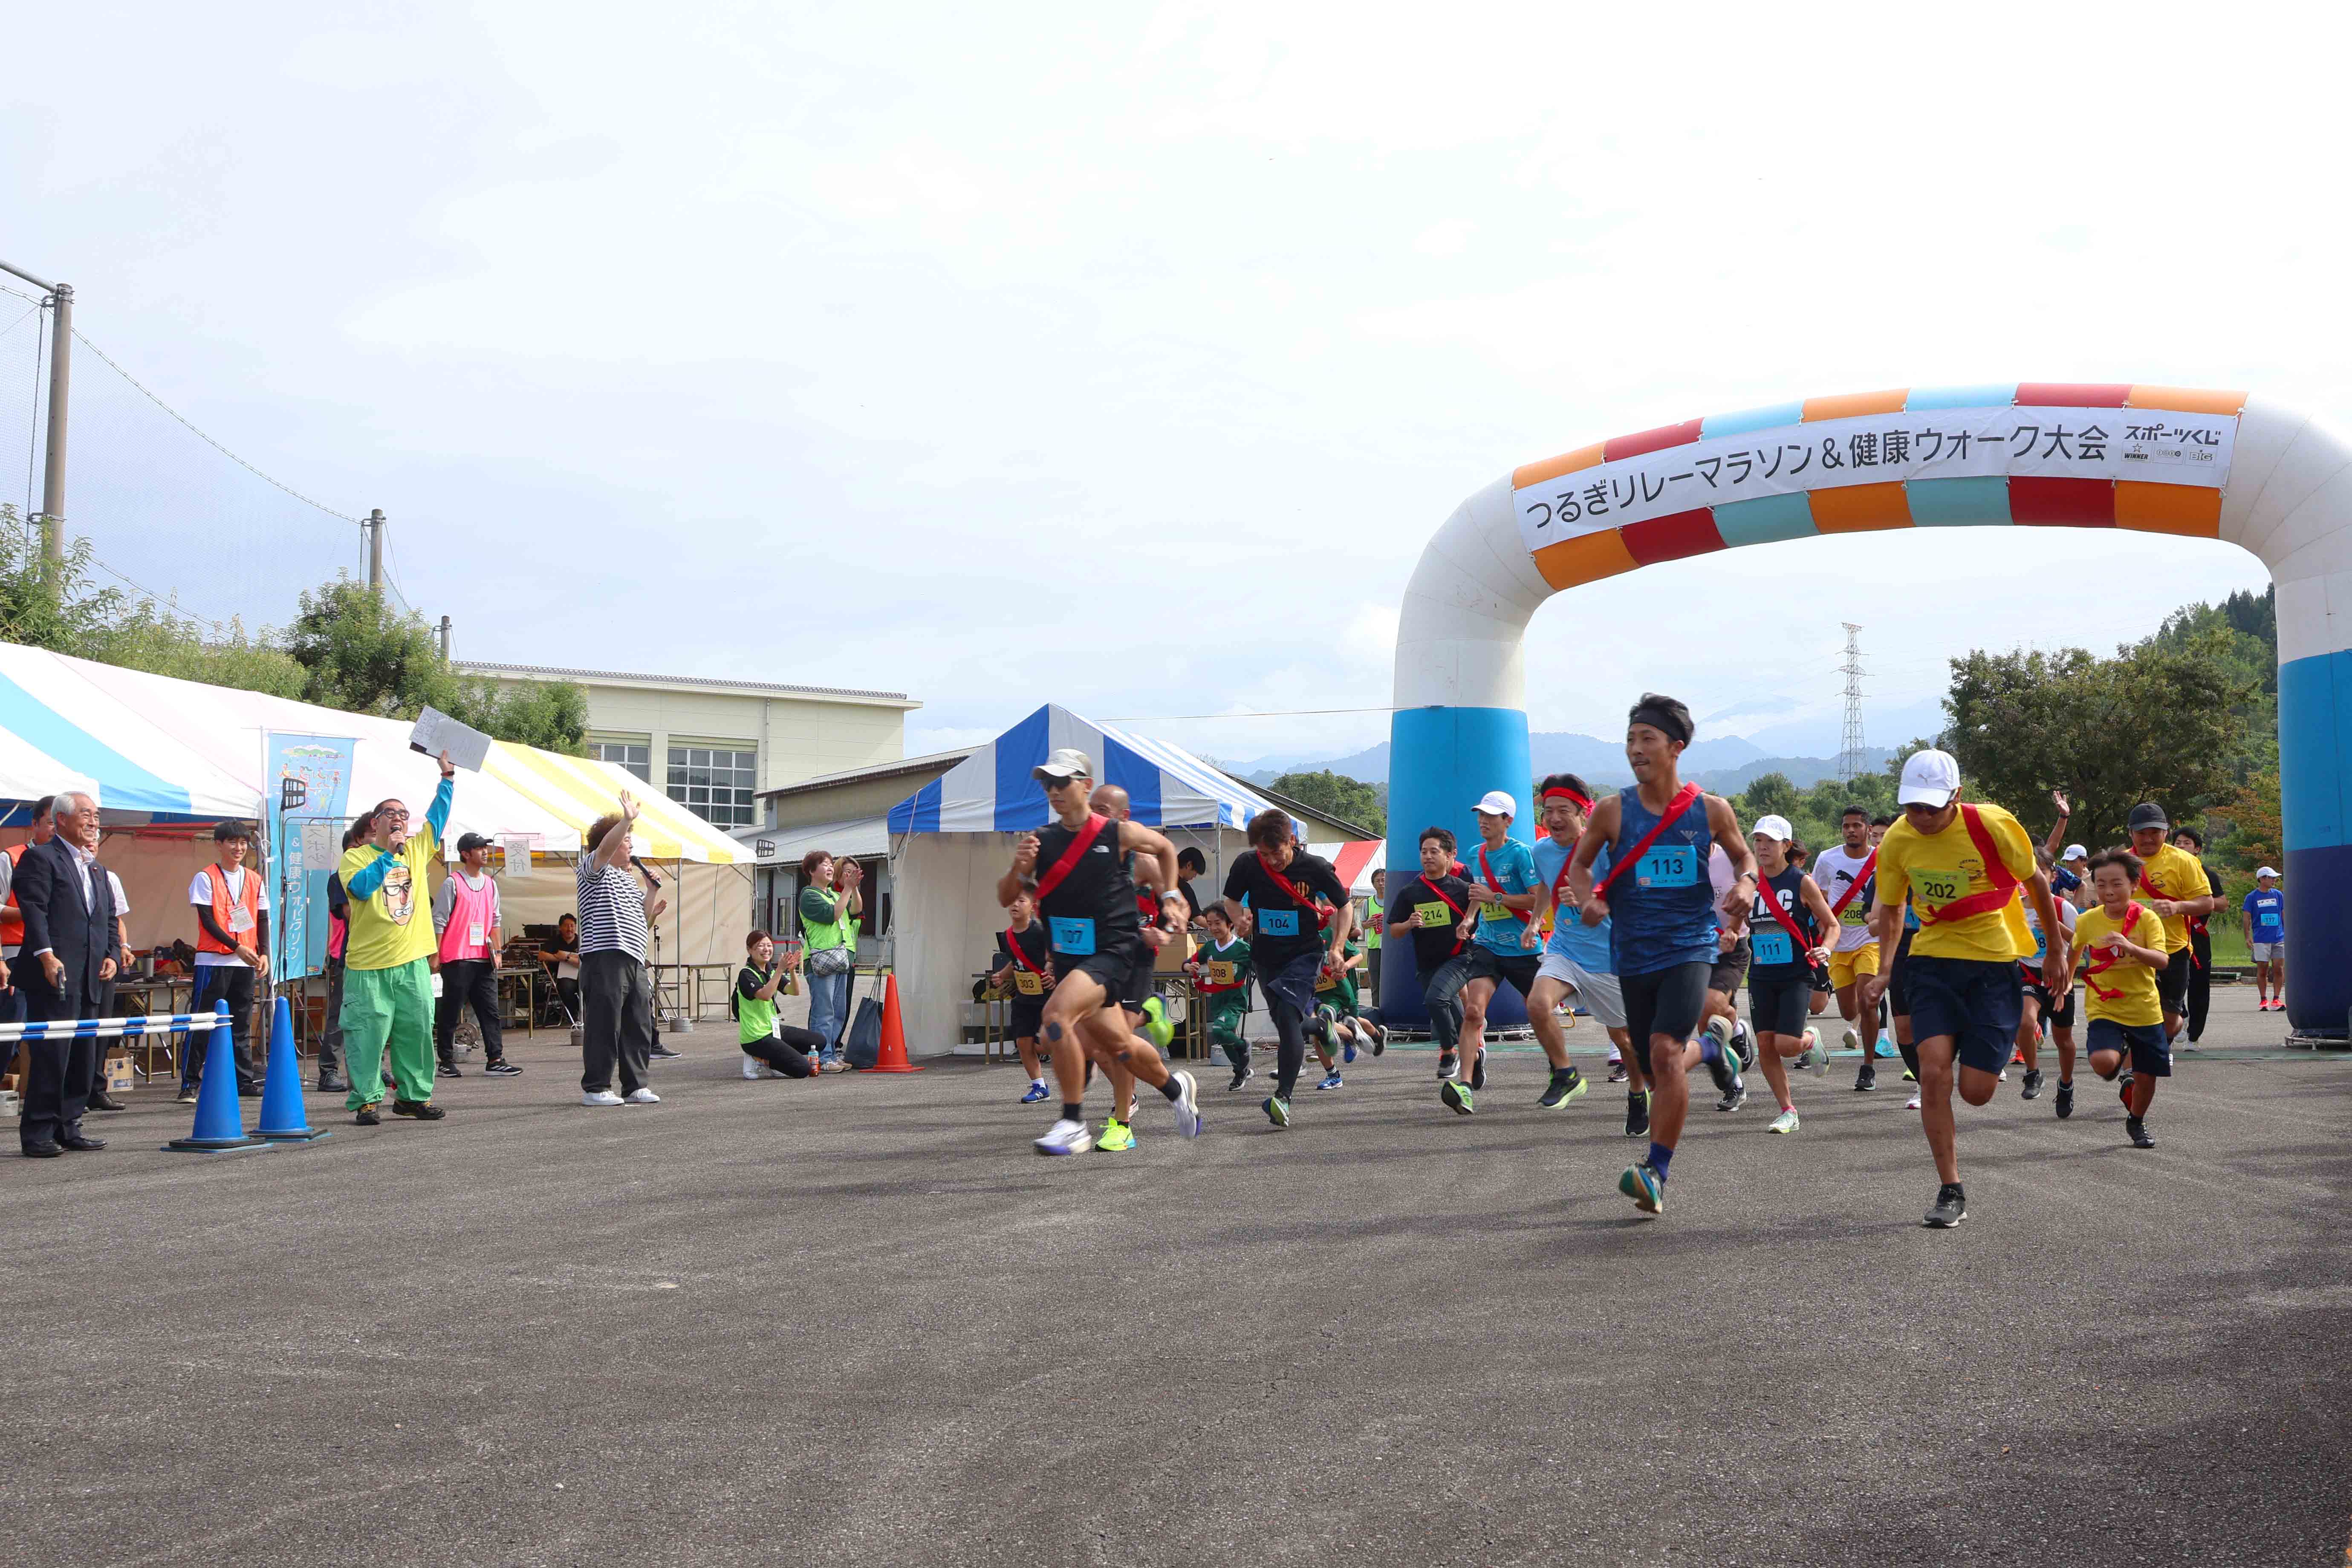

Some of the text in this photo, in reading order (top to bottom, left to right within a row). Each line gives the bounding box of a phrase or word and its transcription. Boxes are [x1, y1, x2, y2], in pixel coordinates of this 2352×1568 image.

[2124, 423, 2221, 445] スポーツくじ
[1652, 859, 1683, 875] 113
[1924, 882, 1956, 899] 202
[1424, 910, 1443, 920] 214
[1844, 910, 1862, 918] 208
[1269, 918, 1289, 928] 104
[1761, 943, 1780, 955] 111
[1211, 968, 1226, 978] 308
[1019, 979, 1034, 988] 303
[1316, 974, 1328, 985] 06
